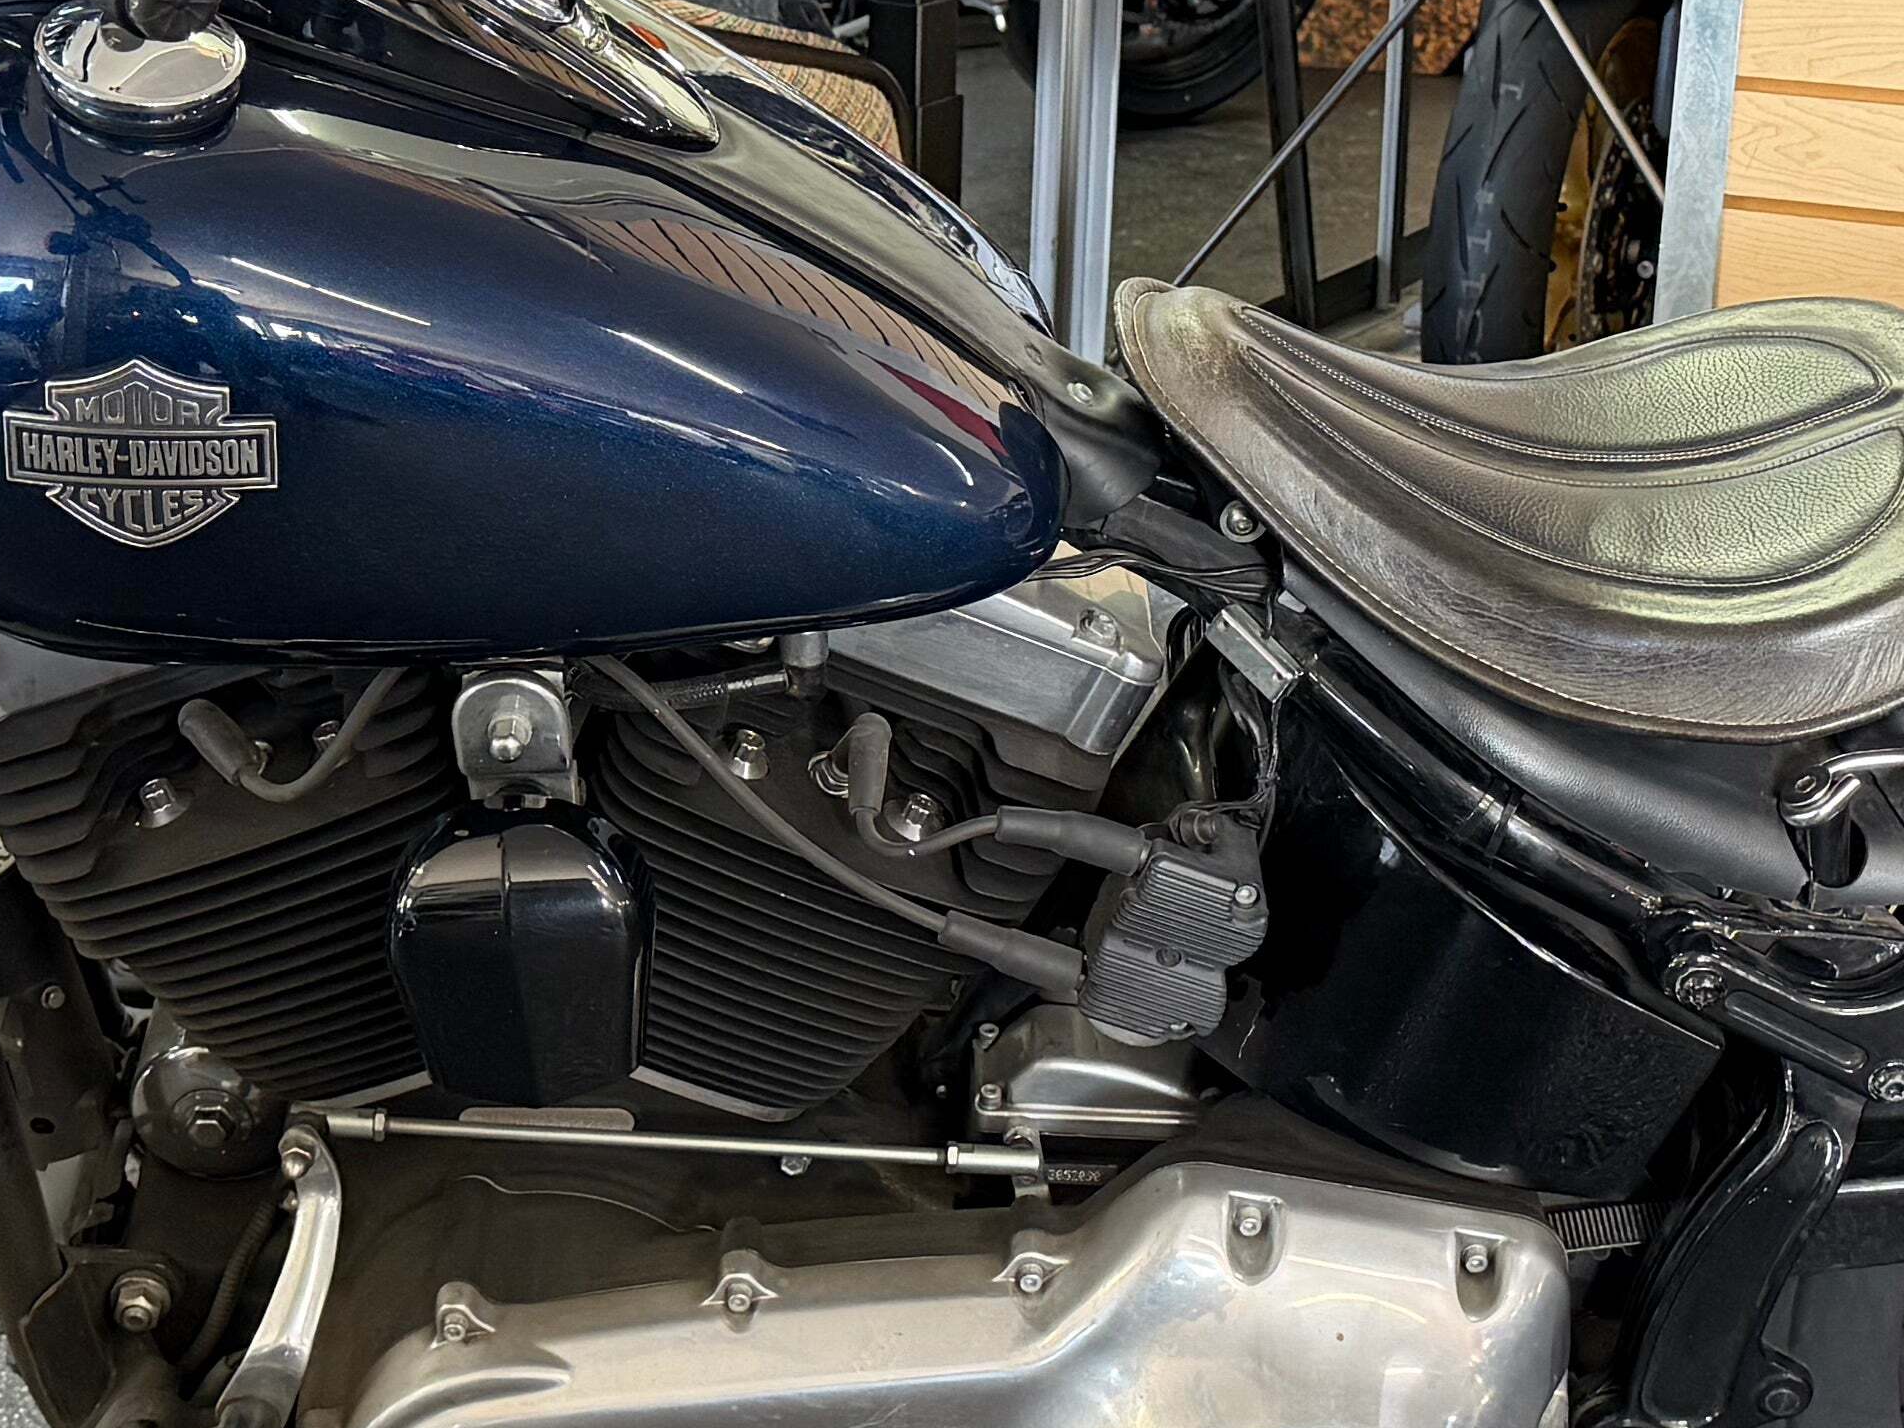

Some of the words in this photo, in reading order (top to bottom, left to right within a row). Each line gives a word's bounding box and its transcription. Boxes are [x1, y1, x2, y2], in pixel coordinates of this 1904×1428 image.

[75, 381, 201, 426] MOTOR
[21, 431, 259, 477] HARLEY-DAVIDSON
[79, 488, 205, 533] CYCLES
